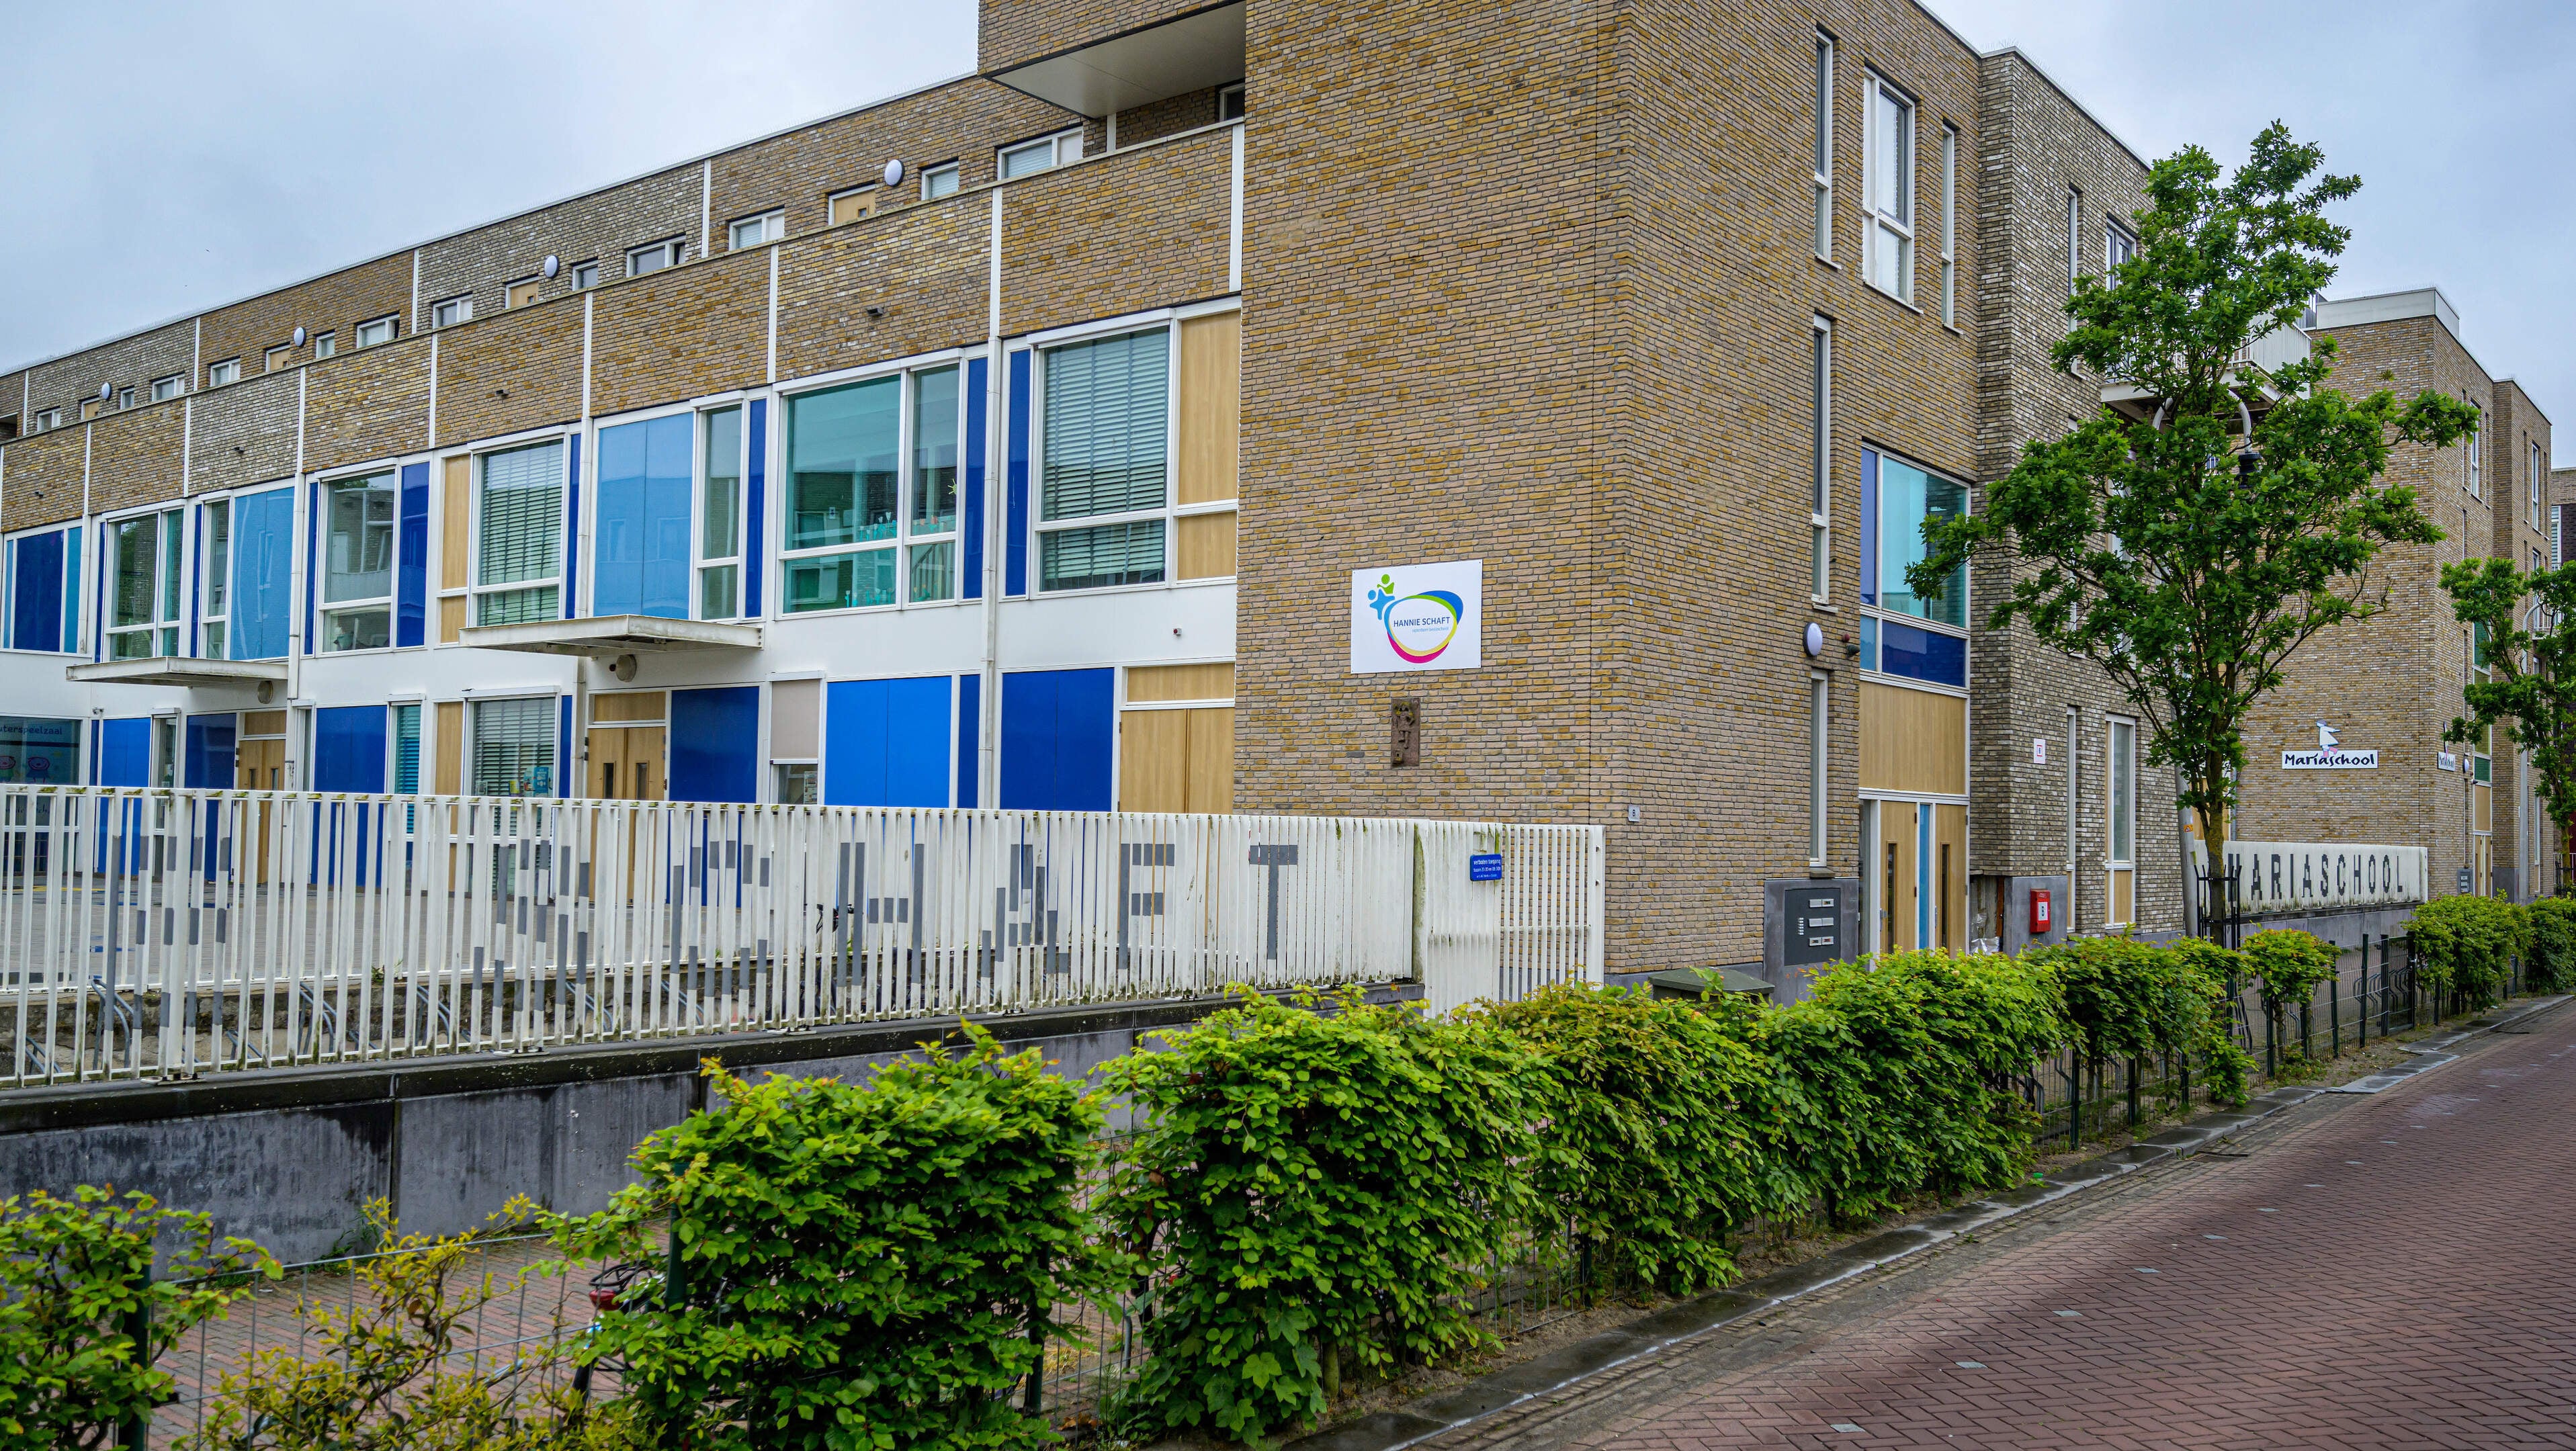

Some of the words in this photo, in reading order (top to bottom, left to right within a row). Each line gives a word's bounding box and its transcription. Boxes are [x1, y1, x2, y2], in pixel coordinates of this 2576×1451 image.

[1393, 619, 1420, 627] HANNIE
[1422, 617, 1450, 625] SCHAFT
[2284, 753, 2375, 766] Mariaschool
[2228, 854, 2403, 902] MARIASCHOOL
